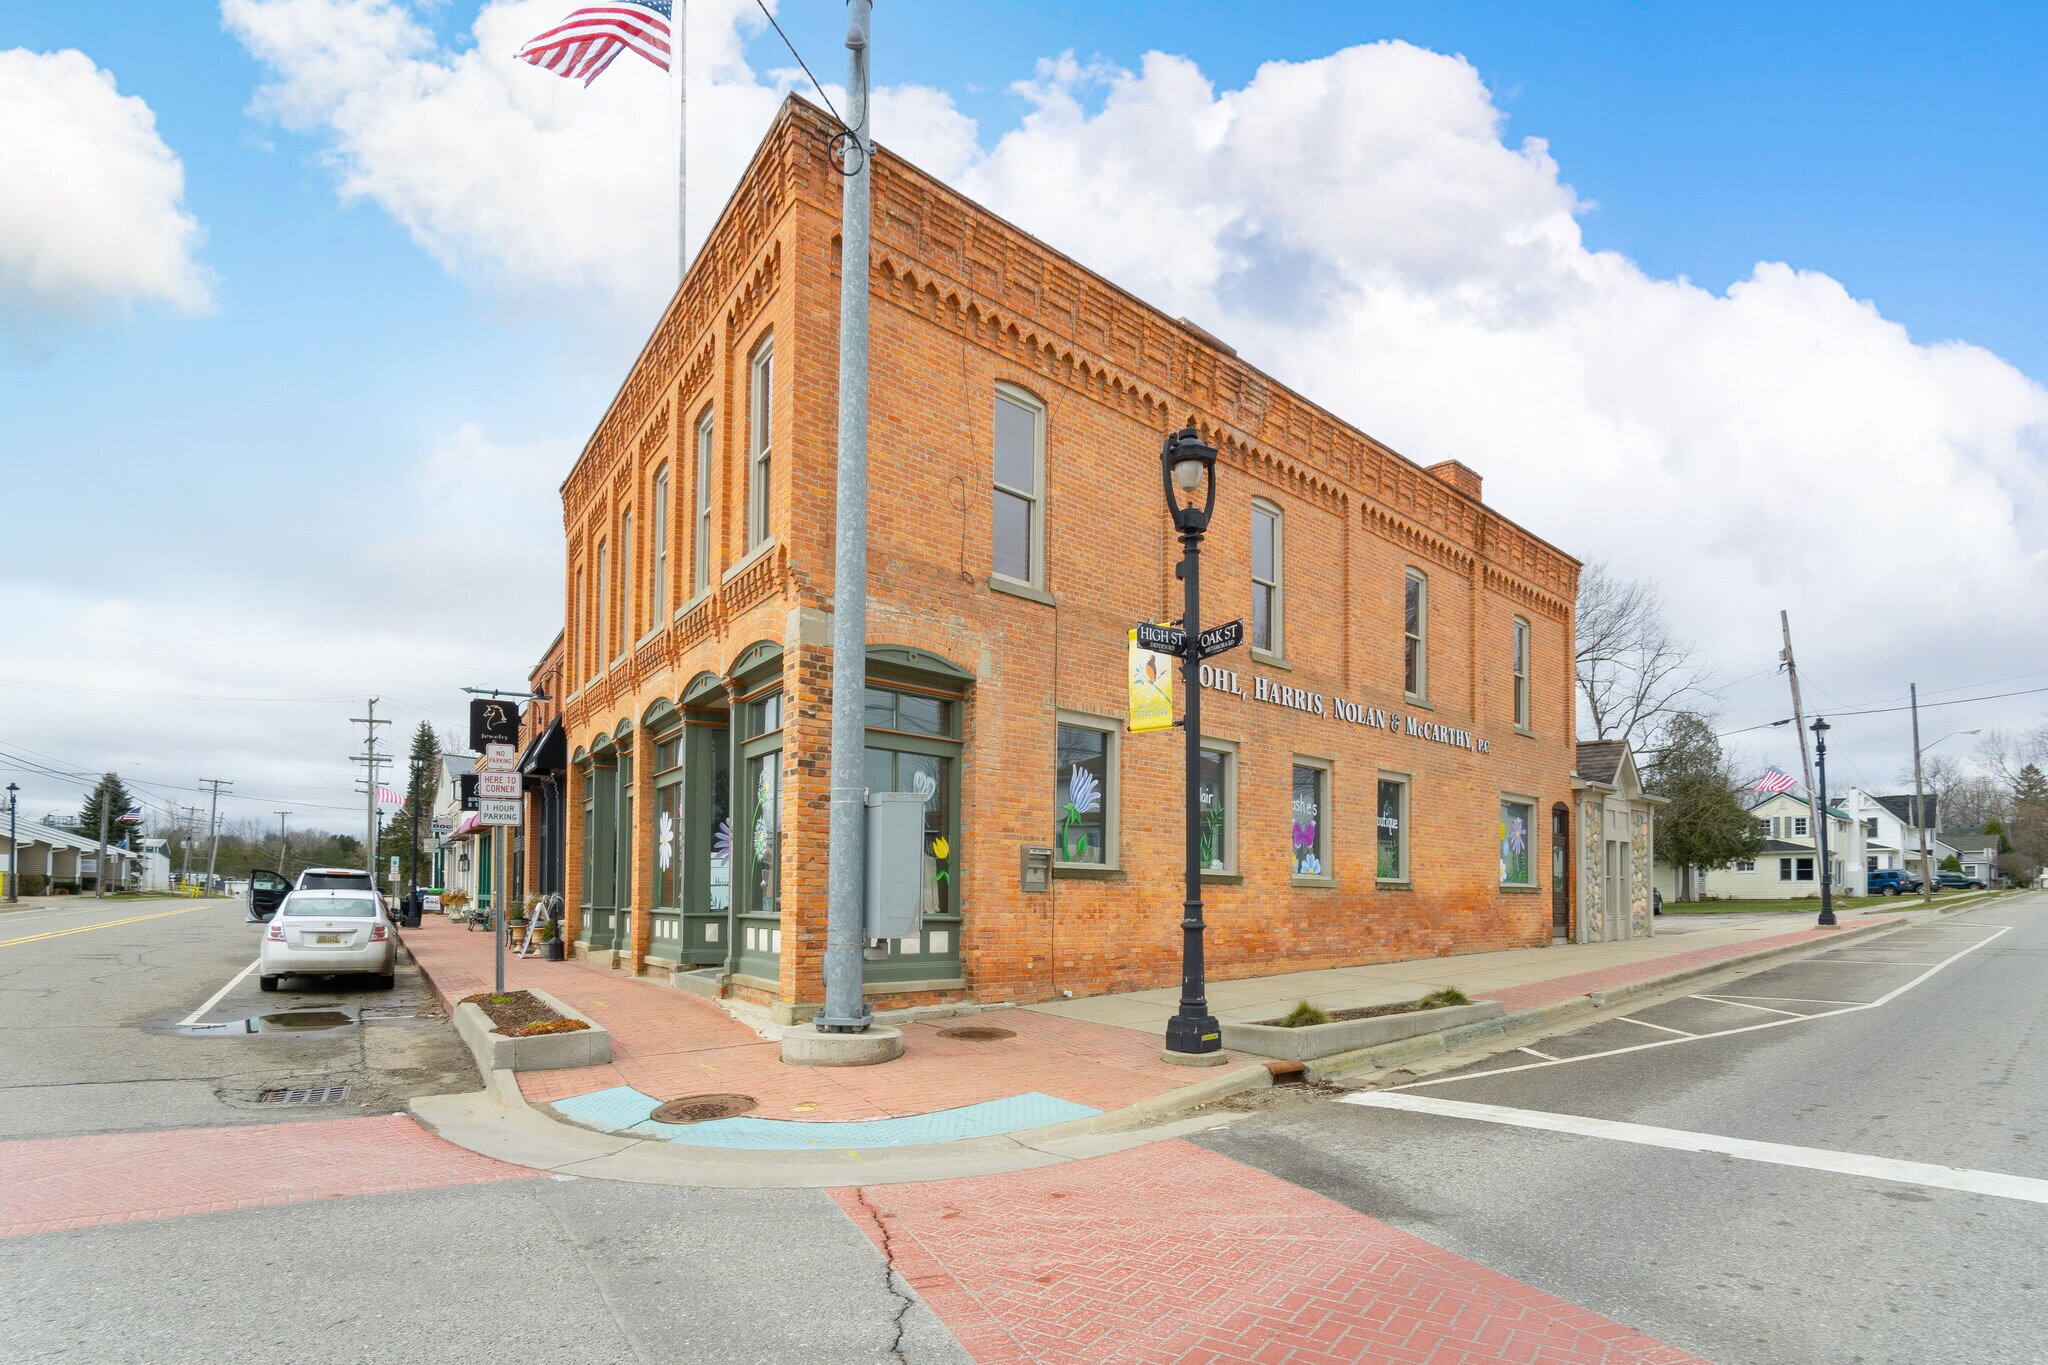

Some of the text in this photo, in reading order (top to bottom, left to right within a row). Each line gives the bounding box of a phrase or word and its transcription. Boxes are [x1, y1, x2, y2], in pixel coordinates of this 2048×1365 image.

[1141, 626, 1184, 646] HIGH ST
[1201, 624, 1237, 647] OAK ST
[1254, 676, 1327, 719] HARRIS,
[1333, 697, 1386, 729] NOLAN
[1390, 713, 1400, 732] &
[481, 733, 508, 741] Jewelry
[489, 757, 512, 765] PARKING
[484, 775, 517, 785] HERE TO
[485, 784, 515, 793] CORNER
[493, 804, 515, 812] HOUR
[483, 812, 517, 821] PARKING
